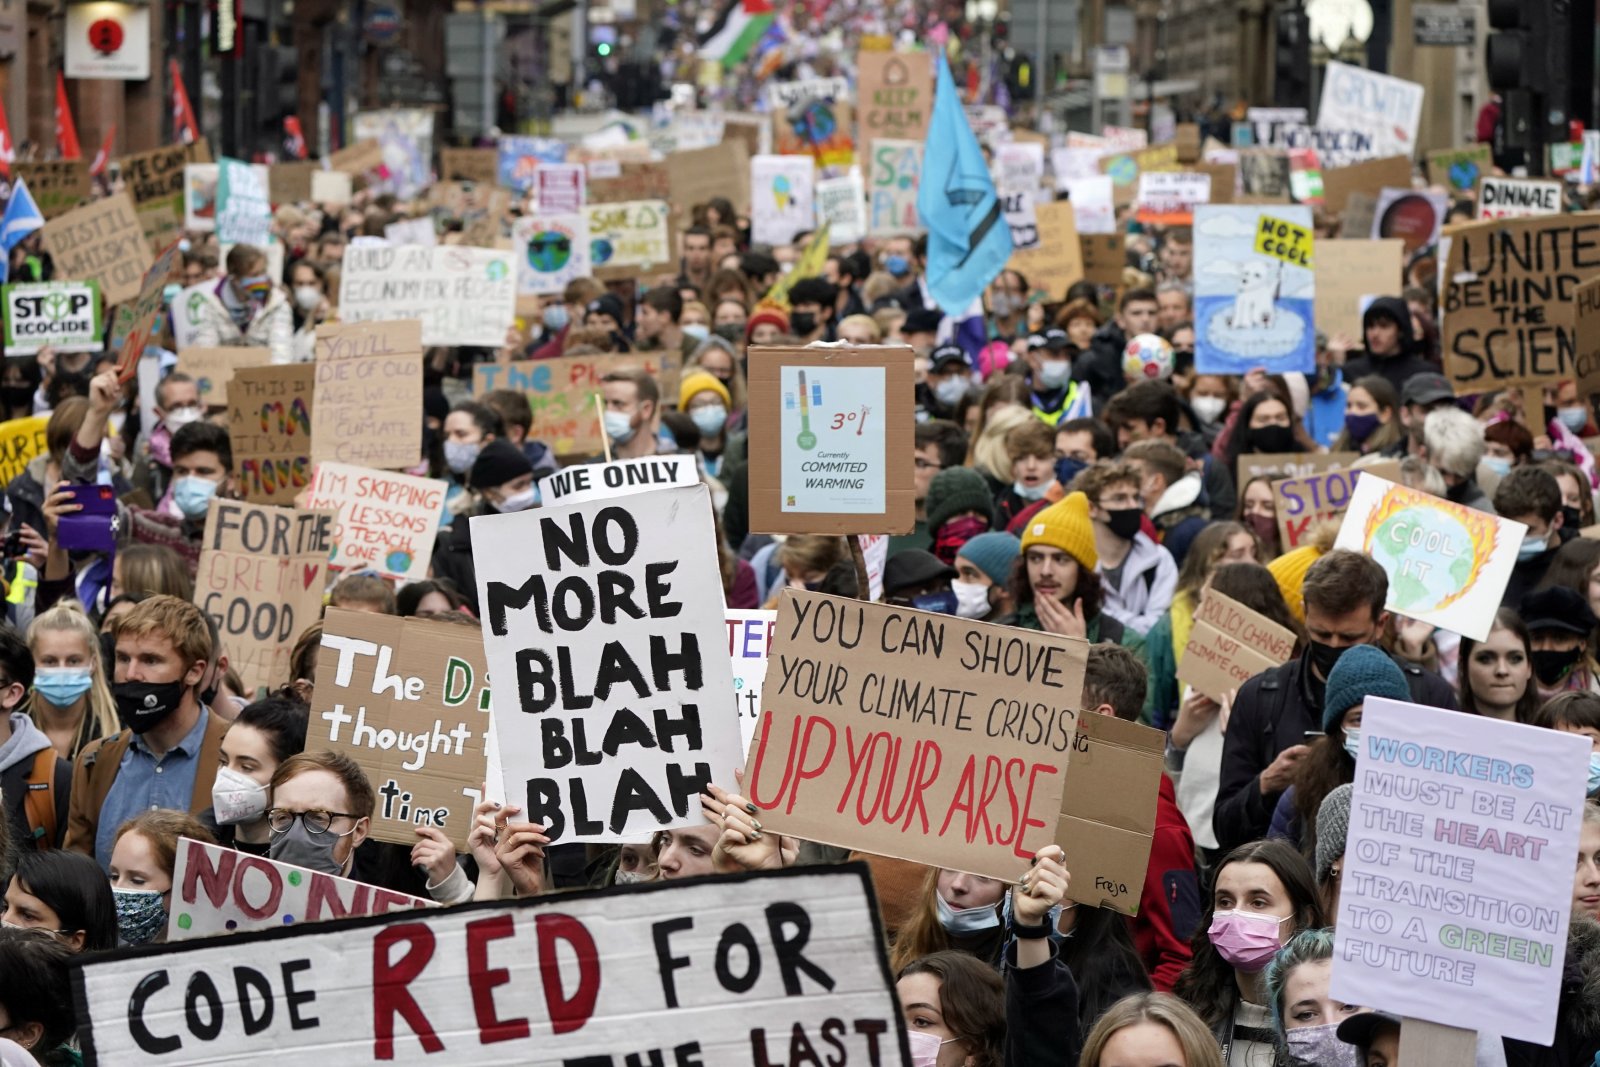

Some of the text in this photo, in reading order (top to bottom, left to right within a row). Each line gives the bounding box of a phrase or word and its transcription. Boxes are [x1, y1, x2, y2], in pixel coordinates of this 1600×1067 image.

[1483, 183, 1557, 209] DINNAE
[51, 208, 136, 255] DISTIL
[1262, 218, 1305, 244] NOT
[1462, 224, 1600, 277] UNITE
[59, 231, 141, 276] WHISKY
[347, 247, 433, 273] BUILD AN
[1263, 239, 1309, 265] COOL
[15, 294, 88, 318] STOP
[344, 278, 421, 303] ECONOMY
[424, 278, 449, 299] FOR
[455, 275, 511, 300] PEOPLE
[1446, 274, 1580, 313] BEHIND
[16, 320, 88, 335] ECOCIDE
[1492, 305, 1545, 325] THE
[242, 381, 286, 396] THIS
[318, 361, 418, 383] DIE OF OLD
[479, 364, 552, 392] The
[319, 386, 357, 404] AGE
[233, 408, 243, 423] A
[335, 421, 410, 438] CLIMATE
[283, 437, 294, 451] A
[335, 441, 416, 463] CHANGE
[816, 451, 850, 459] Currently
[550, 461, 679, 499] WE ONLY
[801, 461, 868, 473] COMMITED
[805, 478, 865, 490] WARMING
[319, 471, 441, 510] I'M SKIPPING
[213, 505, 332, 556] FOR THE
[349, 503, 427, 533] LESSONS
[345, 543, 380, 561] ONE
[350, 526, 412, 550] TEACH
[540, 506, 639, 572] NO
[1390, 521, 1457, 557] COOL
[208, 552, 302, 594] GRETA
[1401, 558, 1433, 582] IT
[204, 592, 294, 643] GOOD
[487, 560, 683, 636] MORE
[790, 597, 1066, 688] YOU CAN SHOVE
[1203, 596, 1293, 662] POLICY CHANGE
[1215, 634, 1241, 656] NOT
[320, 633, 425, 701] The
[515, 632, 704, 714] BLAH
[1186, 639, 1231, 671] CLIMATE
[777, 654, 1076, 754] YOUR CLIMATE CRISIS
[321, 704, 472, 771] thought
[541, 703, 704, 769] BLAH
[1368, 735, 1535, 789] WORKERS
[378, 778, 450, 828] time
[527, 762, 713, 842] BLAH
[748, 711, 1060, 860] UP YOUR ARSE
[1363, 770, 1572, 831] MUST BE AT
[1359, 803, 1549, 861] THE HEART
[1355, 838, 1475, 883] OF THE
[183, 841, 284, 922] NO
[1095, 876, 1128, 897] Freja
[1352, 870, 1560, 934] TRANSITION
[1347, 904, 1554, 968] TO A GREEN
[127, 901, 836, 1061] CODE RED FOR
[1343, 938, 1476, 986] FUTURE
[750, 1017, 888, 1067] LAST
